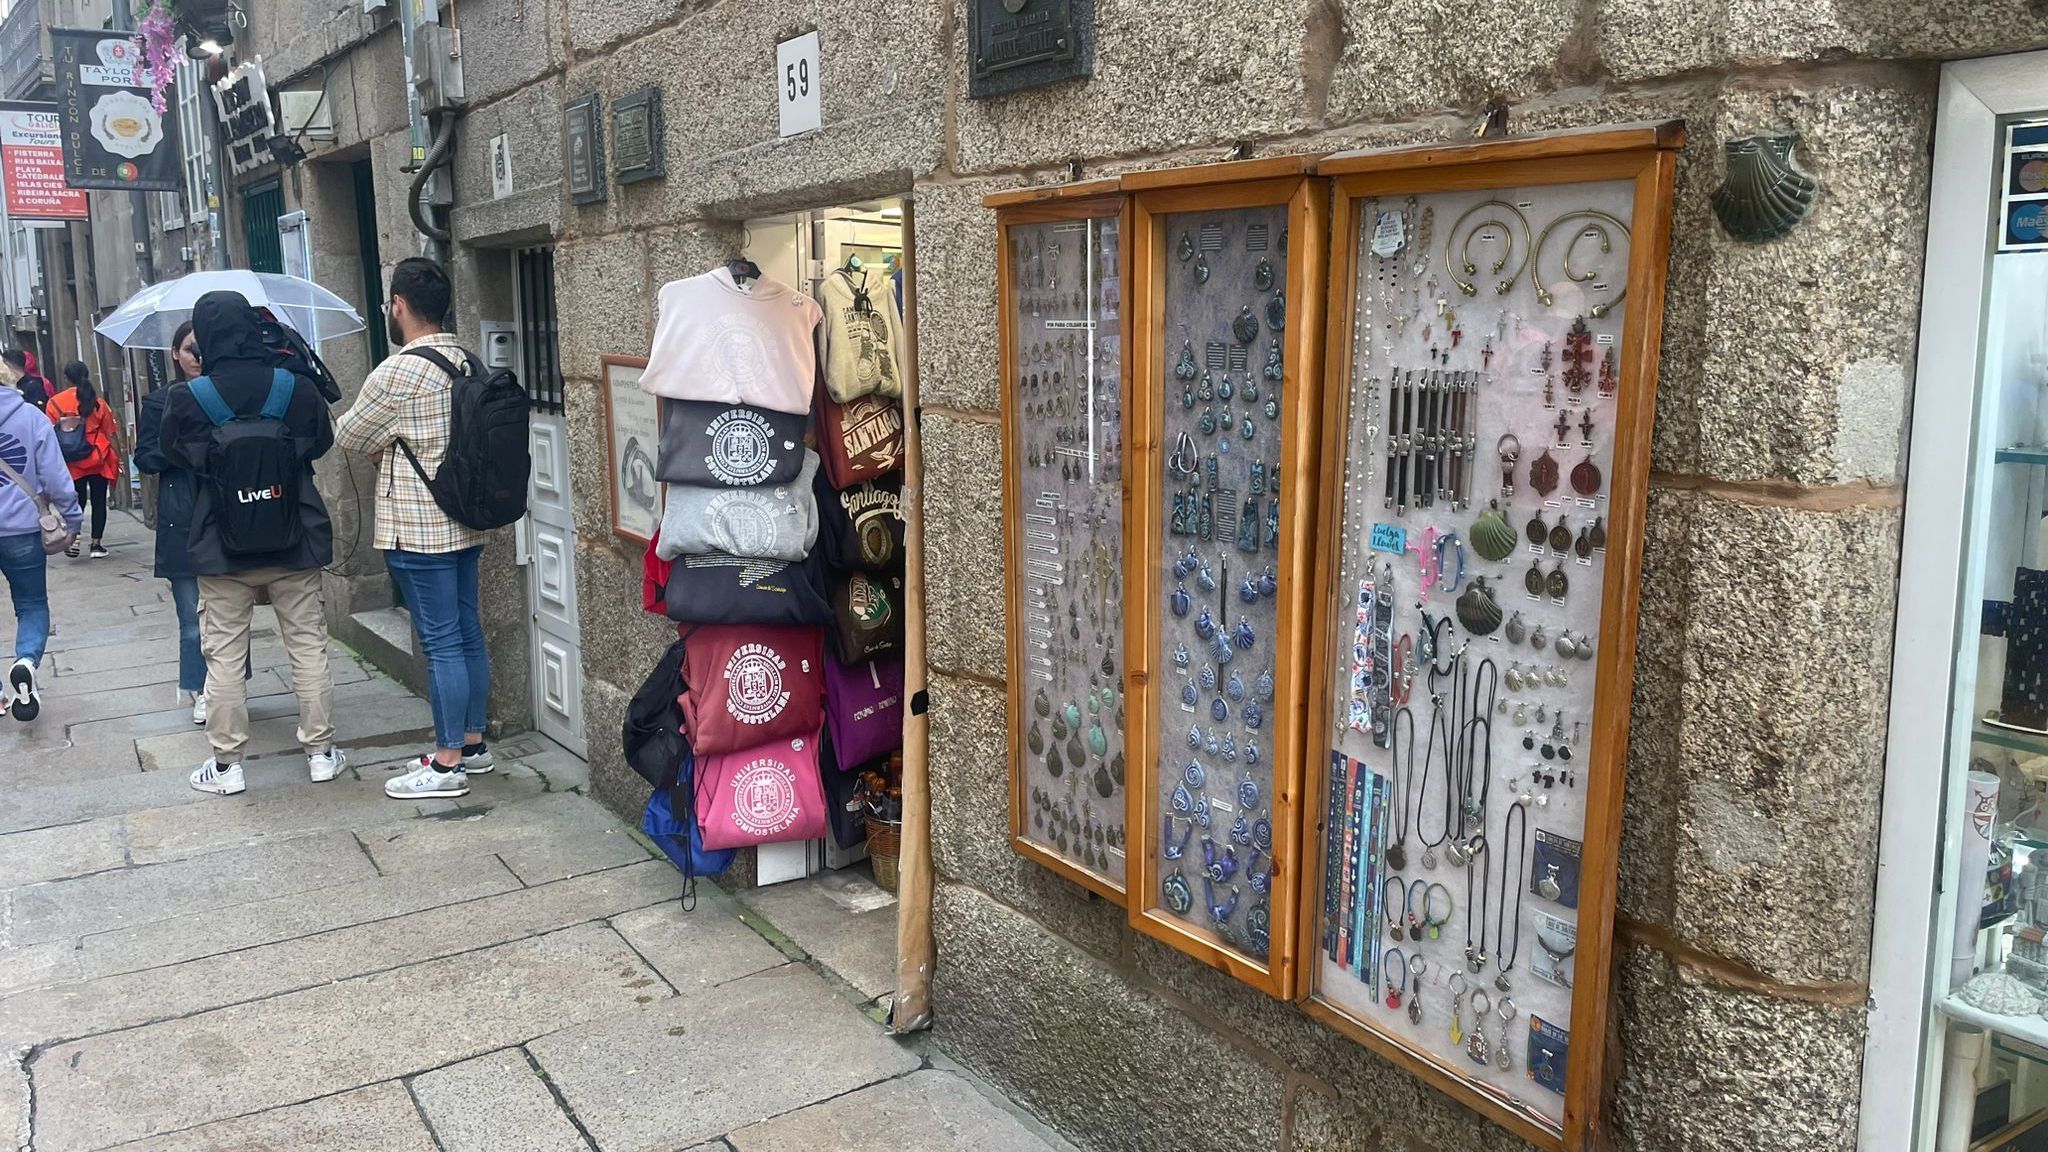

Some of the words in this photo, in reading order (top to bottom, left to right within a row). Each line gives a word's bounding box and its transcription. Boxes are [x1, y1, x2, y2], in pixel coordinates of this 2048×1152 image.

[101, 76, 133, 85] POR
[786, 57, 809, 103] 59
[12, 131, 61, 139] Excursion
[14, 150, 55, 158] FISTERRA
[70, 132, 83, 175] DULCE
[16, 173, 65, 181] CATEDRALE
[92, 168, 106, 176] DE
[17, 189, 50, 197] RIBEIRA
[51, 190, 80, 198] SACRA
[25, 197, 62, 205] CORUÑA
[705, 409, 775, 437] UNIVERSIDAD
[843, 409, 901, 460] SANTIAGO
[704, 456, 778, 486] COMPOSTELANA
[705, 490, 780, 518] UNIVERSIDAD
[840, 481, 901, 516] Santiago
[723, 643, 786, 679] UNIVERSIDAD
[730, 759, 796, 788] UNIVERSIDAD
[731, 807, 800, 836] COMPOSTELANA
